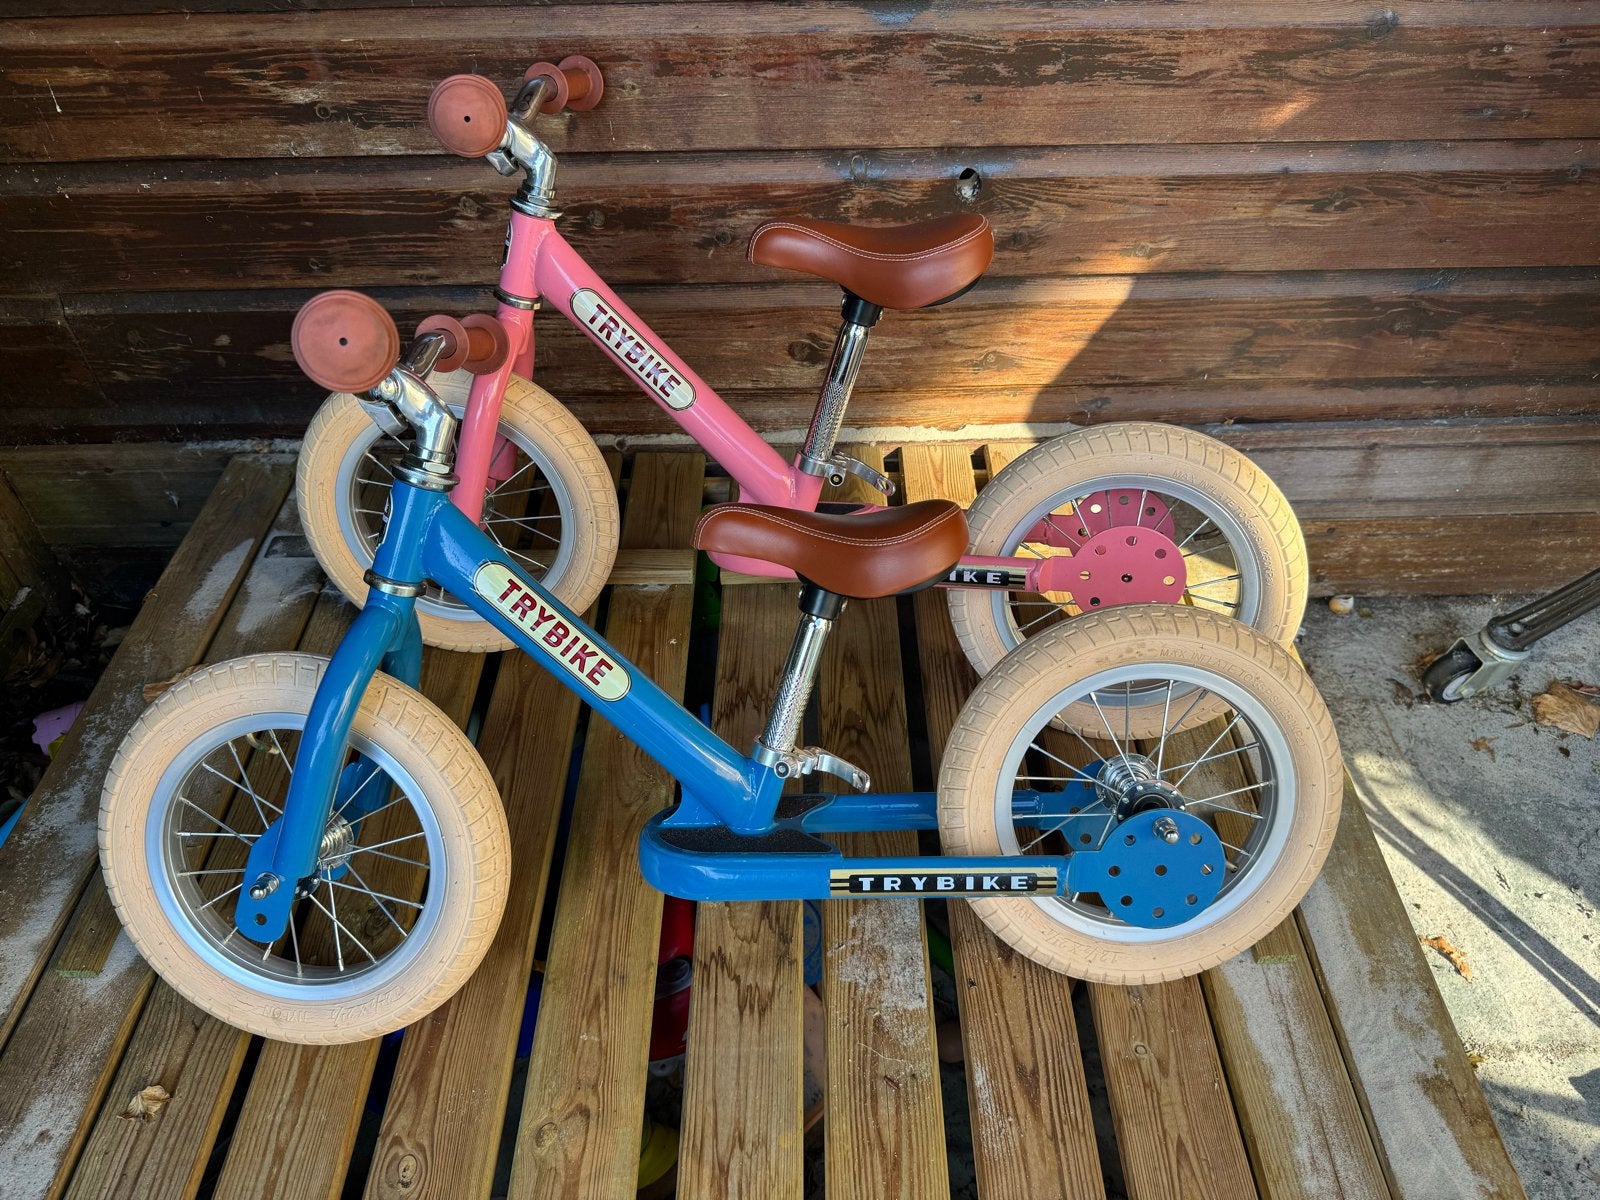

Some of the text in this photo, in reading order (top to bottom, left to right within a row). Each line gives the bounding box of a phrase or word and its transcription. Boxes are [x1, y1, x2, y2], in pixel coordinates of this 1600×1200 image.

[588, 303, 682, 398] TRYBIKE
[498, 578, 614, 686] TRYBIKE
[1159, 648, 1187, 658] MAX
[858, 875, 1028, 891] TRYBIKE
